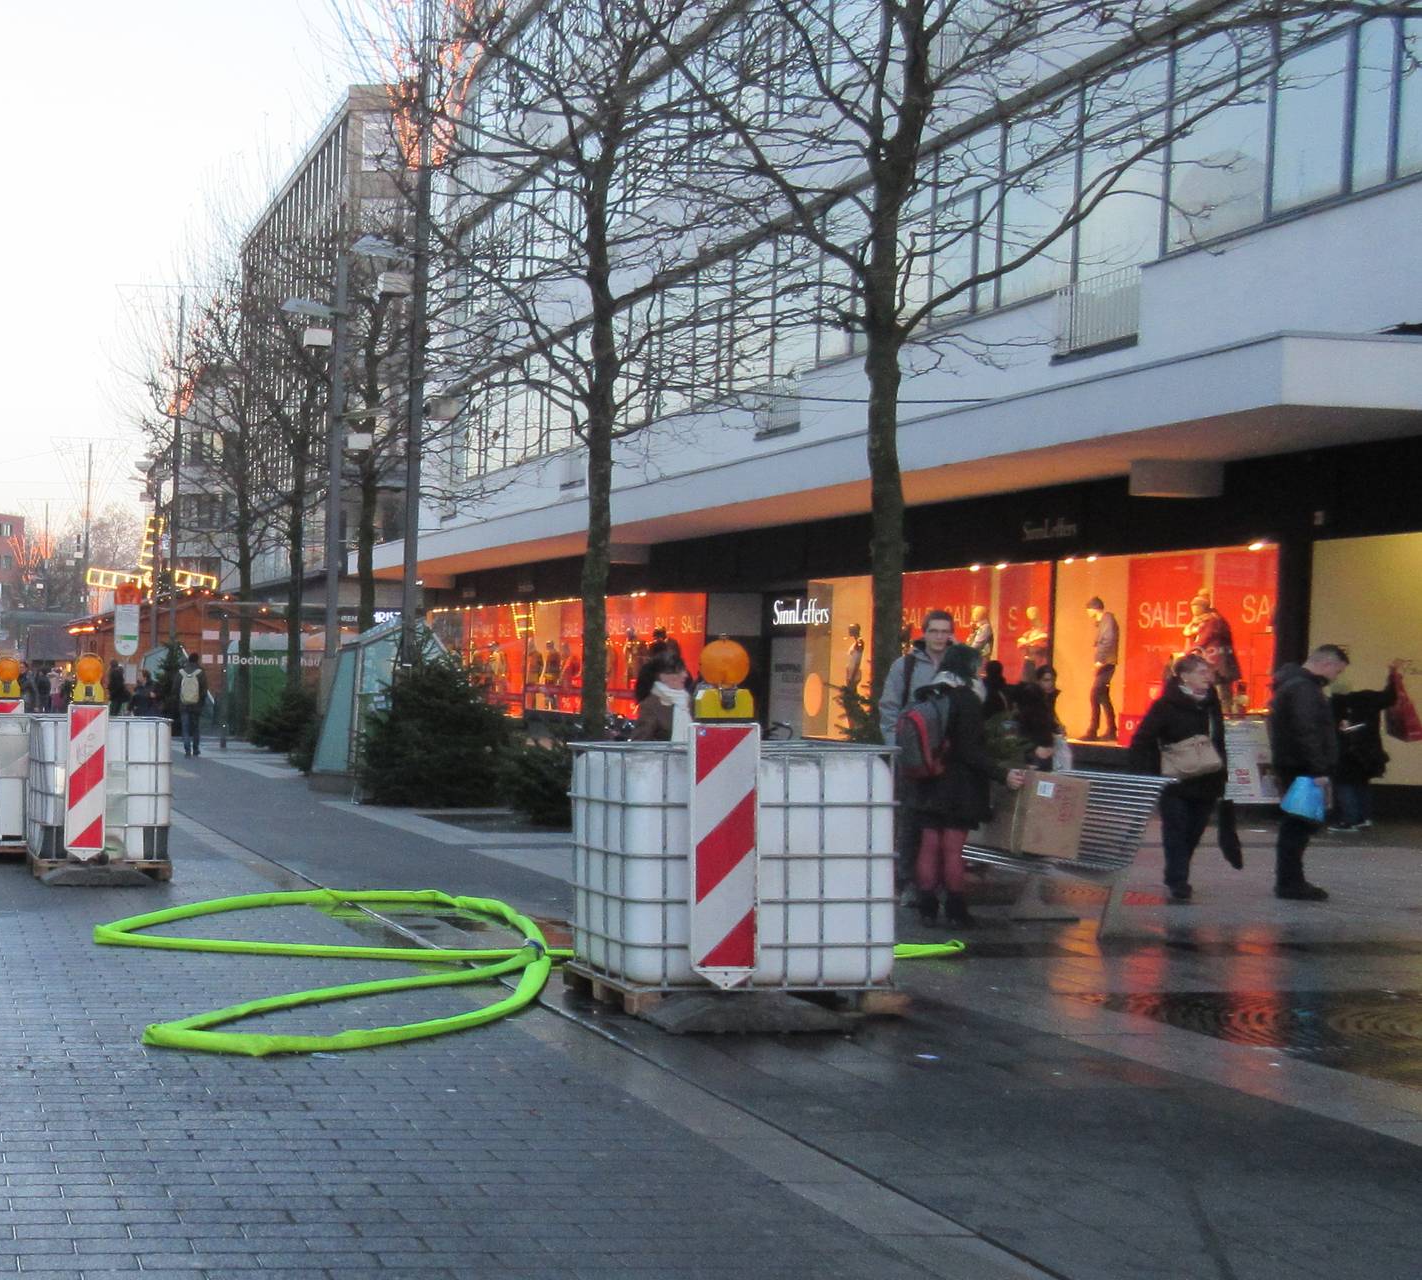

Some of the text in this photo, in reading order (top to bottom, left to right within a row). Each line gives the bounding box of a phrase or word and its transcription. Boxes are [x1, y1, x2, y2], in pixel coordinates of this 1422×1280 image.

[773, 599, 830, 626] SinnLeffers
[1138, 601, 1189, 628] SALE
[681, 615, 702, 634] SALE
[232, 655, 279, 665] Bochum
